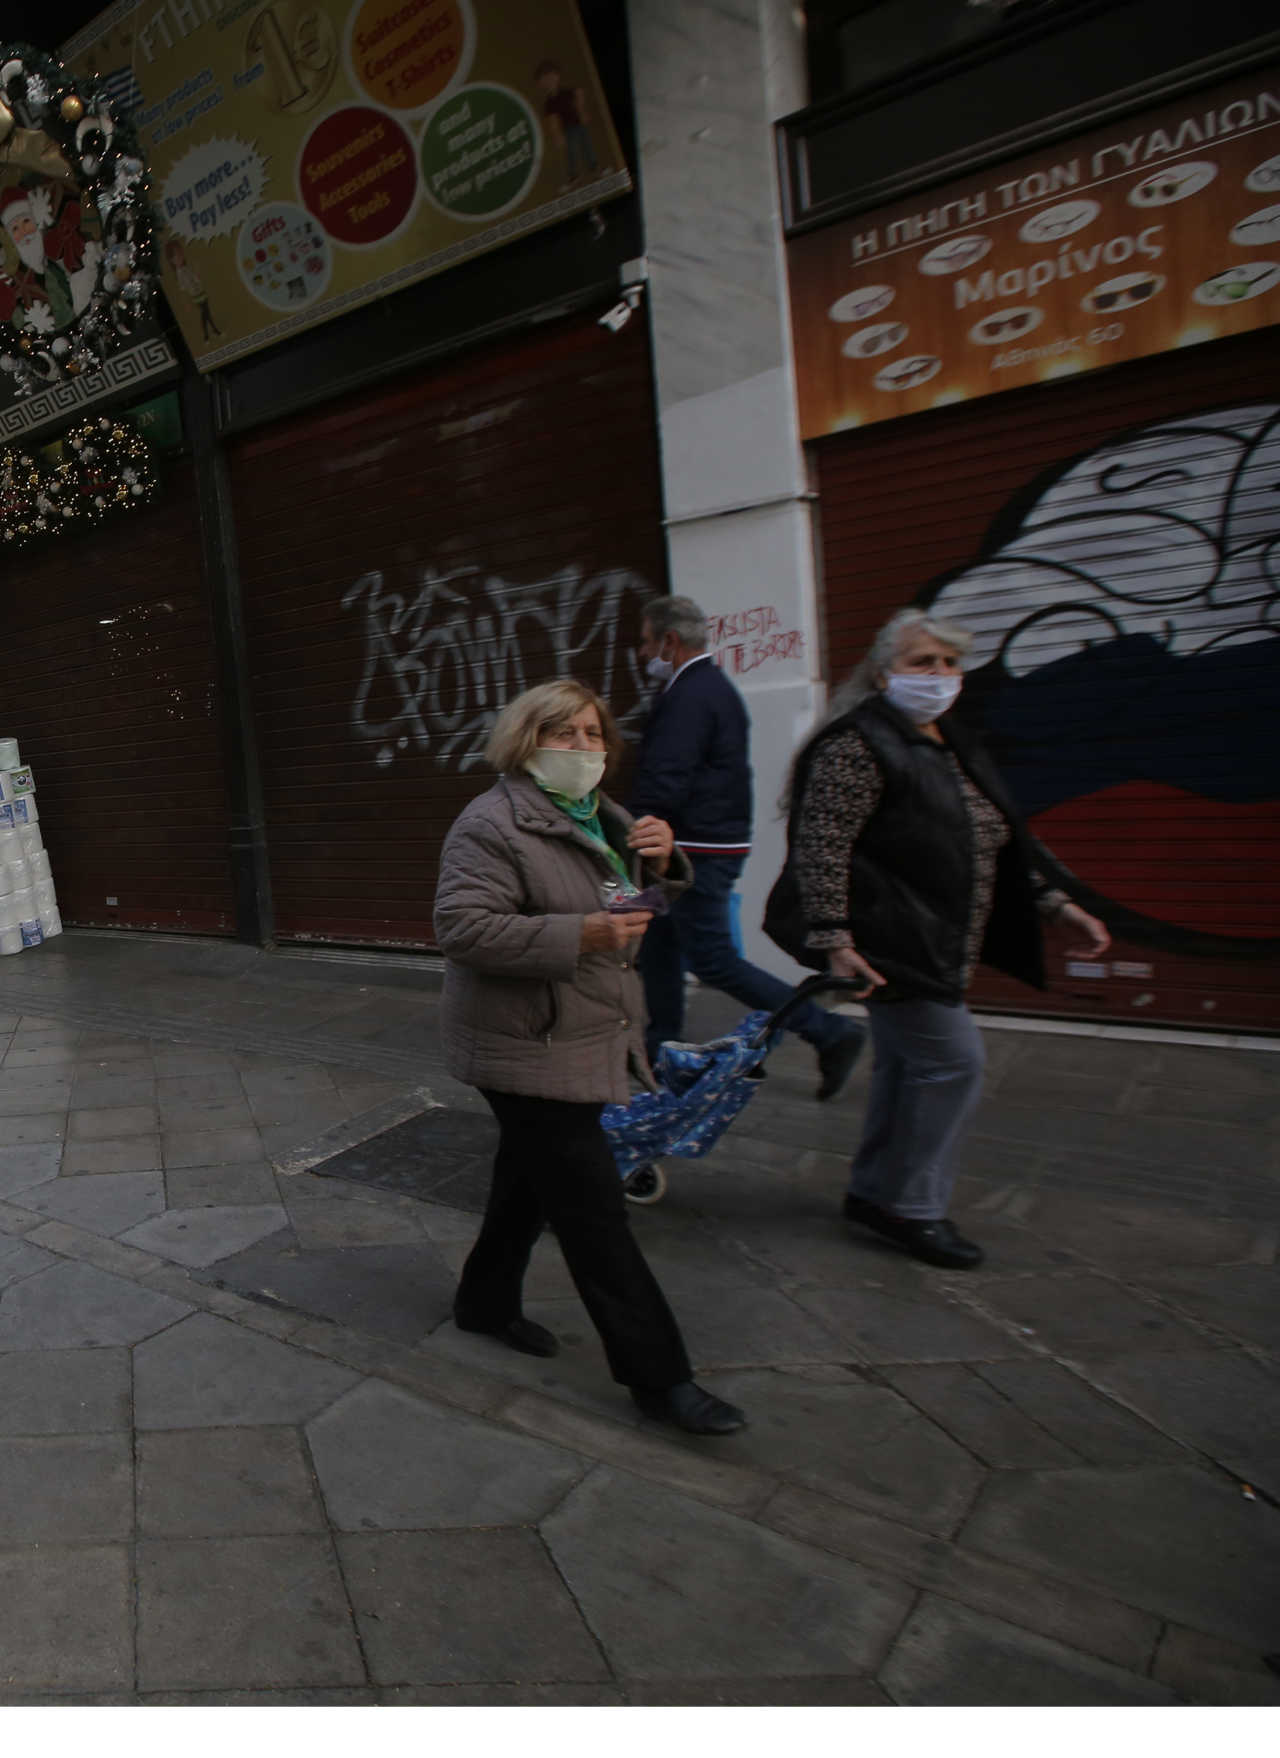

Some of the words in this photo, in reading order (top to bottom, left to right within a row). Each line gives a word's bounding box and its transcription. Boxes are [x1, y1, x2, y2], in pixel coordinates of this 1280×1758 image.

[164, 66, 214, 111] products
[232, 63, 265, 89] from
[438, 100, 472, 137] and
[447, 112, 496, 154] many
[305, 121, 387, 184] Souvenirs
[318, 147, 409, 213] Accessories
[431, 135, 506, 192] products
[506, 118, 529, 145] at
[851, 227, 879, 261] Η
[886, 192, 989, 247] ΠΗΓΗ
[996, 158, 1080, 210] ΤΩΝ
[1091, 91, 1280, 179] ΓΥΑΛΙΩΝ
[163, 190, 195, 219] Buy
[194, 154, 255, 200] more...
[189, 201, 218, 233] Pay
[216, 176, 252, 214] less!
[345, 189, 393, 225] Tools
[251, 213, 288, 244] Gifts
[952, 224, 1166, 311] Μαρίνος
